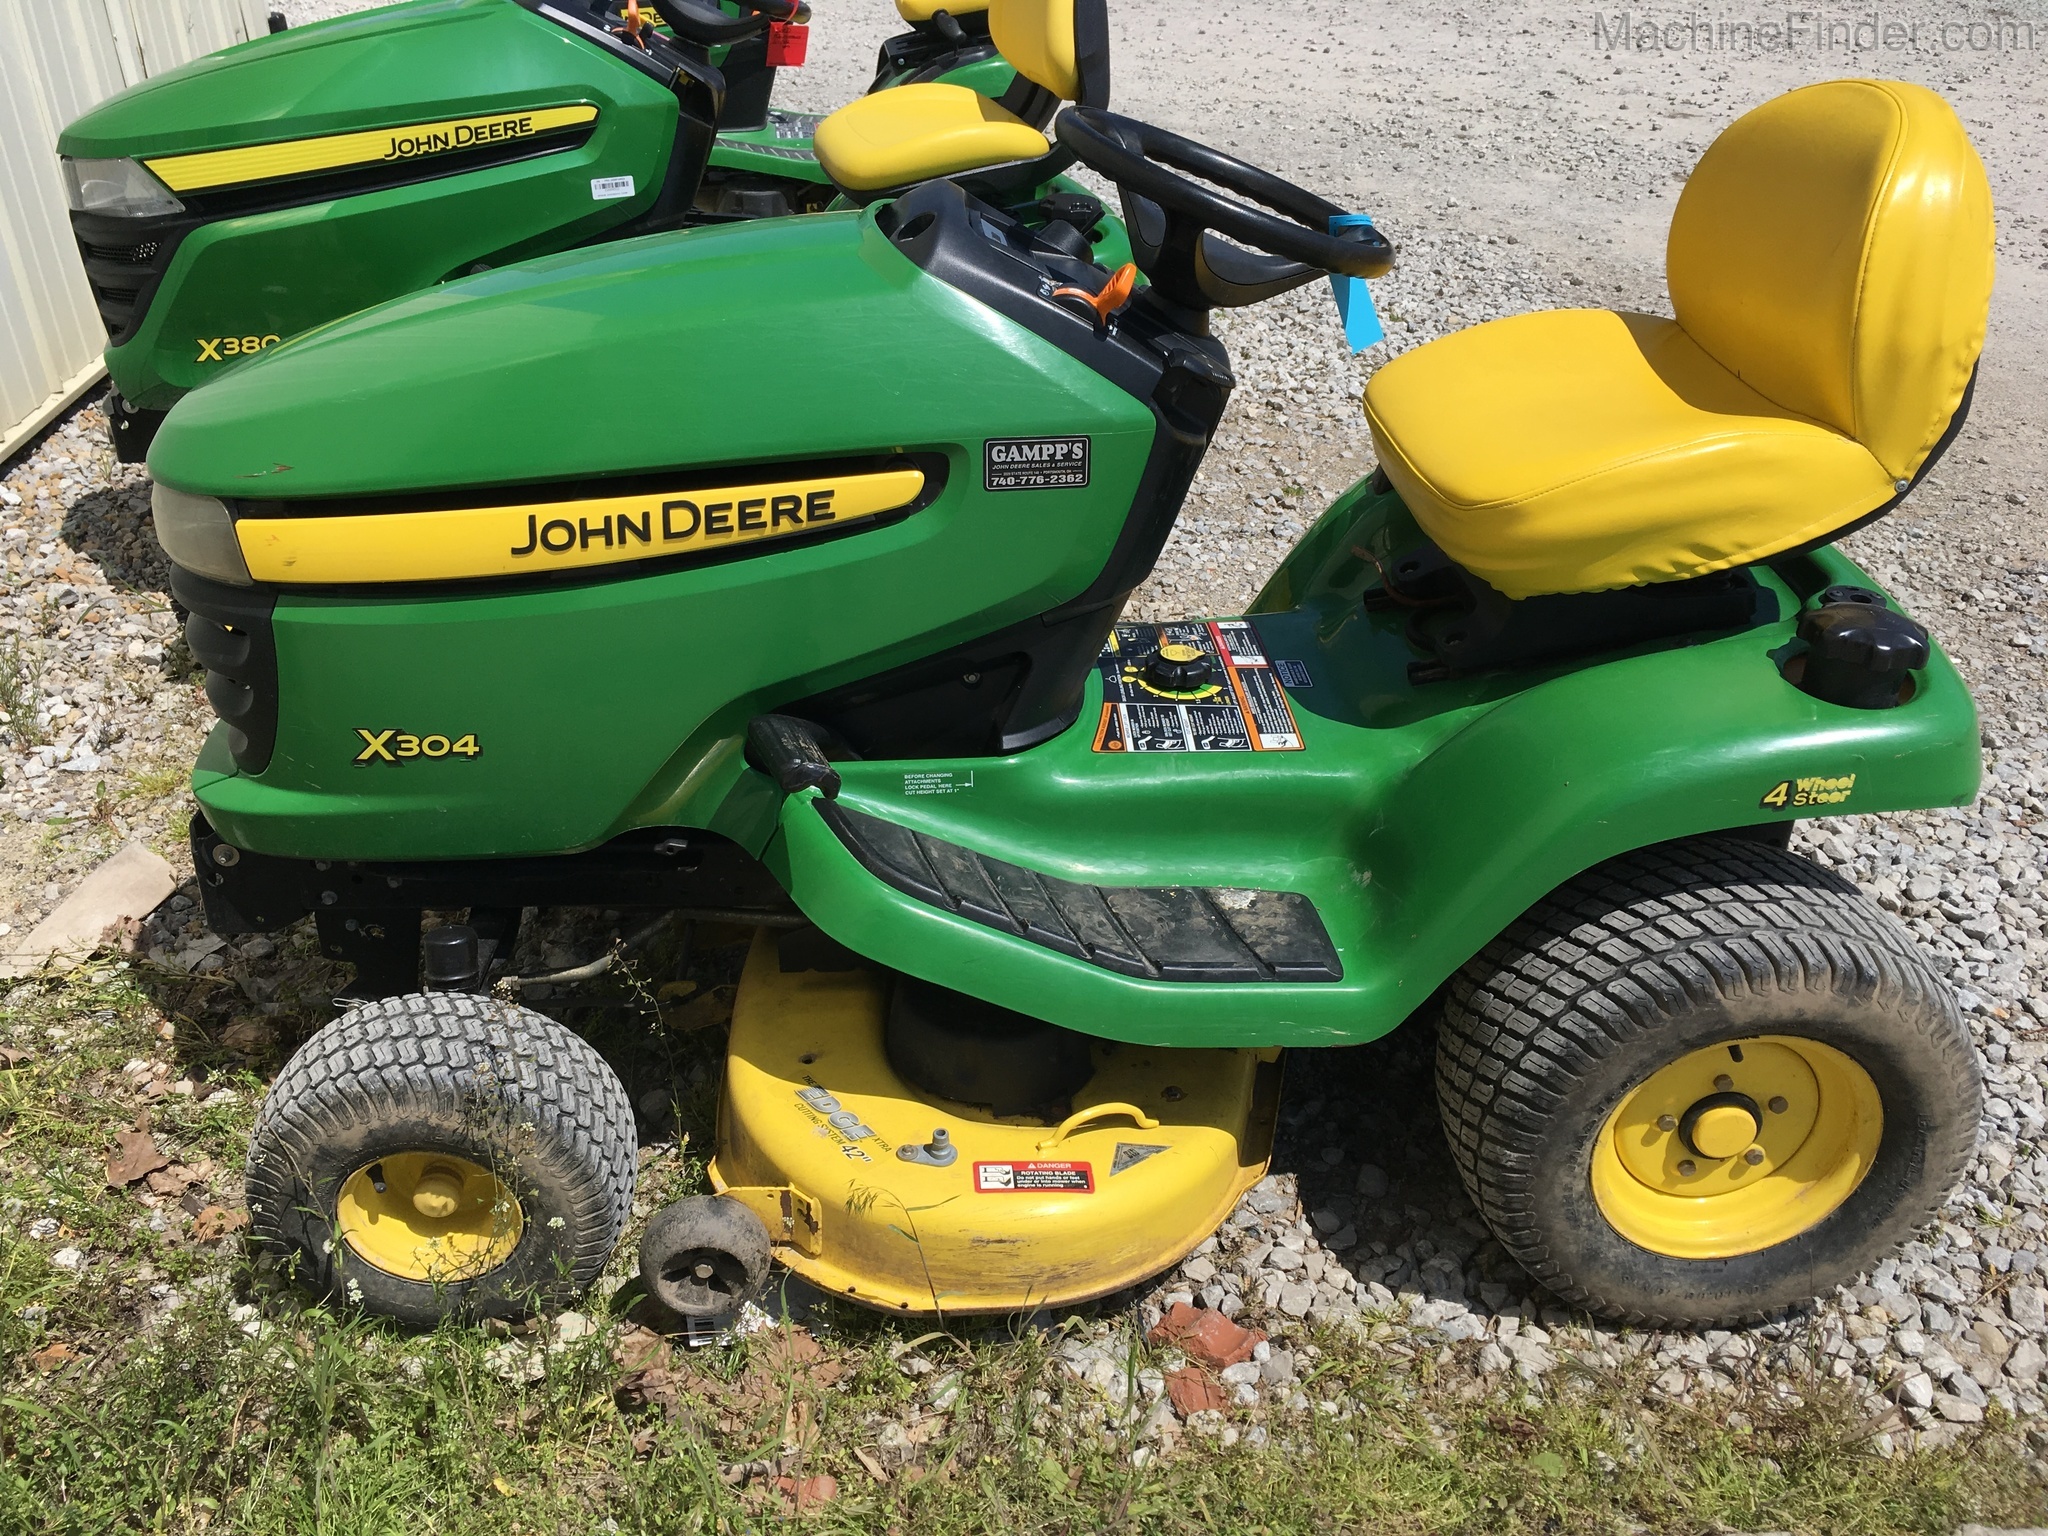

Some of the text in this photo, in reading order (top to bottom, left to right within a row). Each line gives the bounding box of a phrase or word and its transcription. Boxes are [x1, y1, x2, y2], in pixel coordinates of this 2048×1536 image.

[384, 117, 535, 160] JOHN DEERE
[991, 443, 1083, 462] GAMPP'S
[991, 474, 1083, 486] 740-776-2362
[511, 490, 835, 555] JOHN DEERE
[353, 728, 482, 764] X304
[1761, 781, 1790, 808] 4
[802, 1075, 817, 1085] THE
[794, 1086, 892, 1152] EDGE XTRA
[794, 1103, 872, 1162] CUTTING SYSTEM 42"
